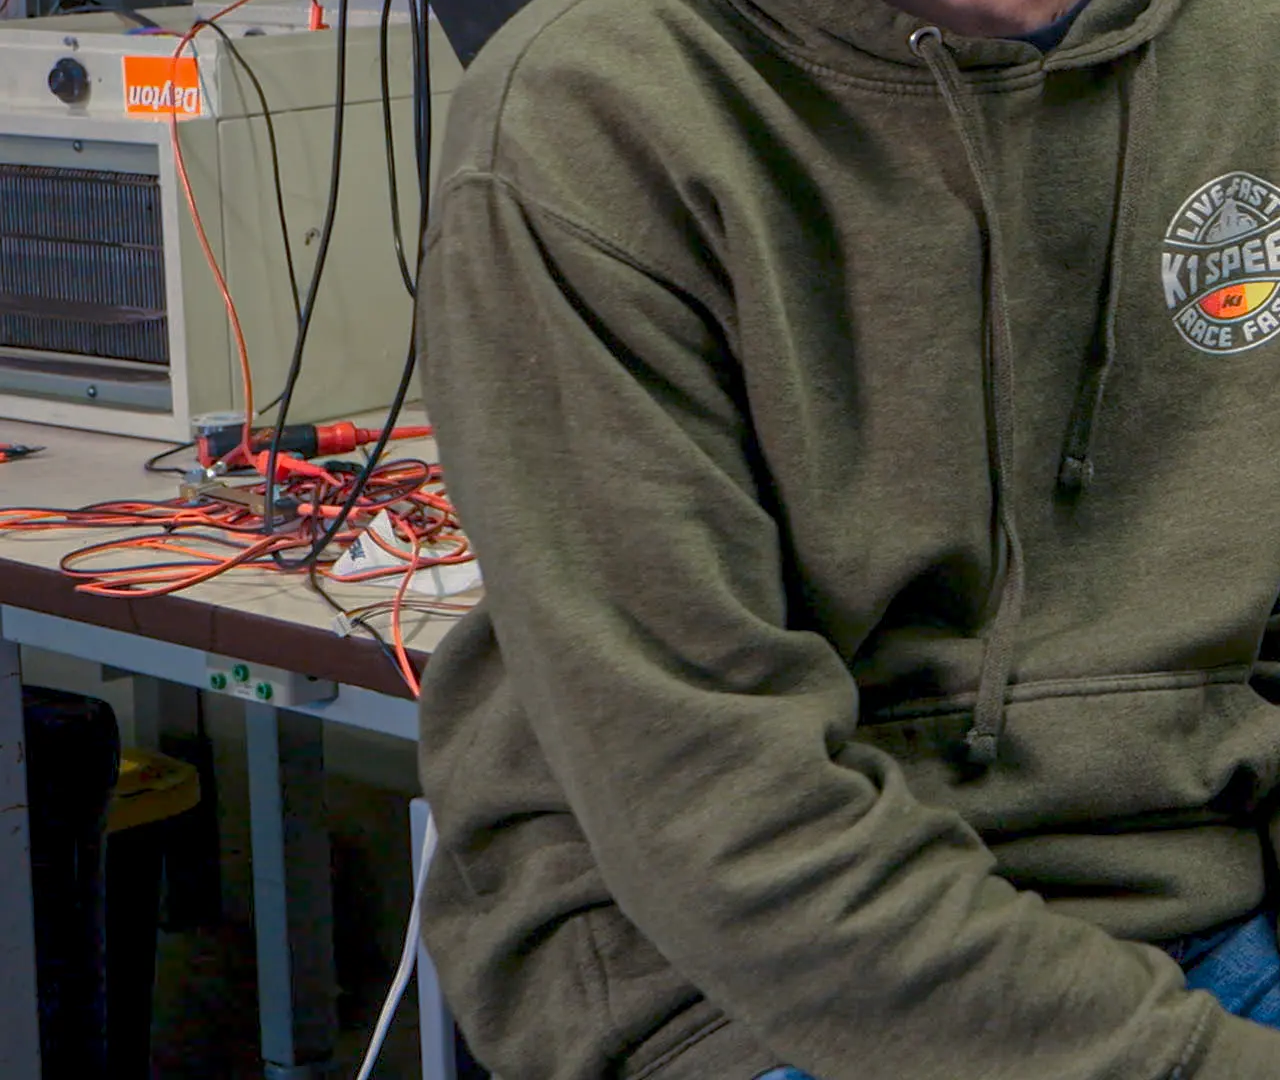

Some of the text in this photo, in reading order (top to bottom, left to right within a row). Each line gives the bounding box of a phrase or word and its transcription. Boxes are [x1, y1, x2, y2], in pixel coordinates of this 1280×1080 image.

[129, 79, 198, 112] Dayton
[1176, 184, 1225, 241] LIVE
[1161, 252, 1199, 309] K1
[1180, 307, 1233, 347] RACE
